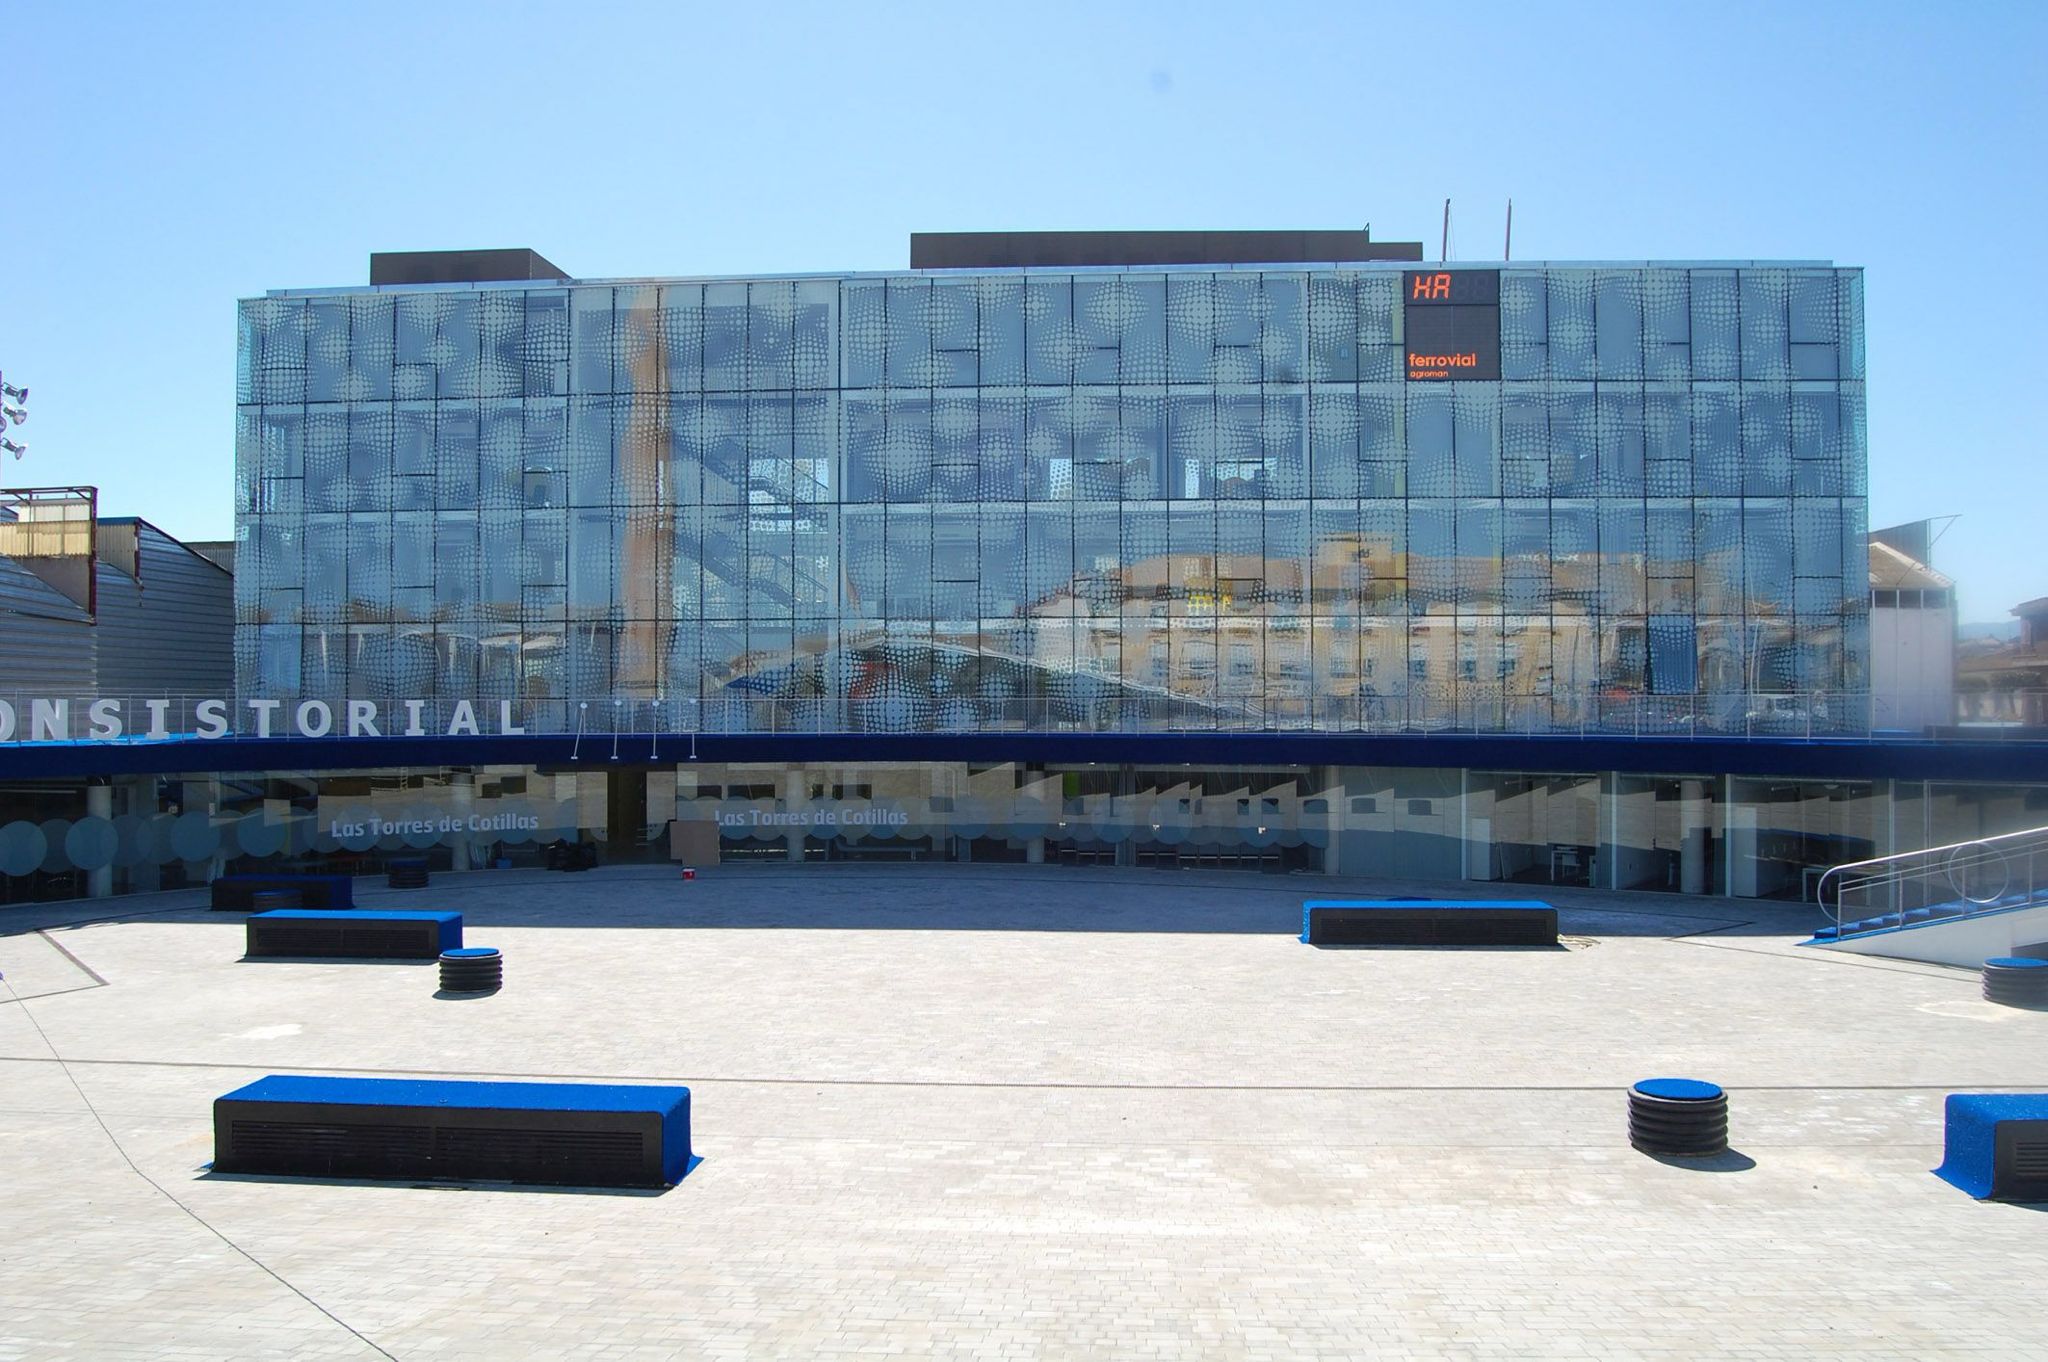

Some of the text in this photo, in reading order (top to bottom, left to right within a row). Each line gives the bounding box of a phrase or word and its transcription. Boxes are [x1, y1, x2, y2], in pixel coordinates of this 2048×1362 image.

[1409, 353, 1476, 367] ferrovial
[1410, 370, 1449, 379] agroman
[714, 808, 909, 826] Las Torres de Cotillas
[331, 813, 539, 838] Las Torres de Cotillas
